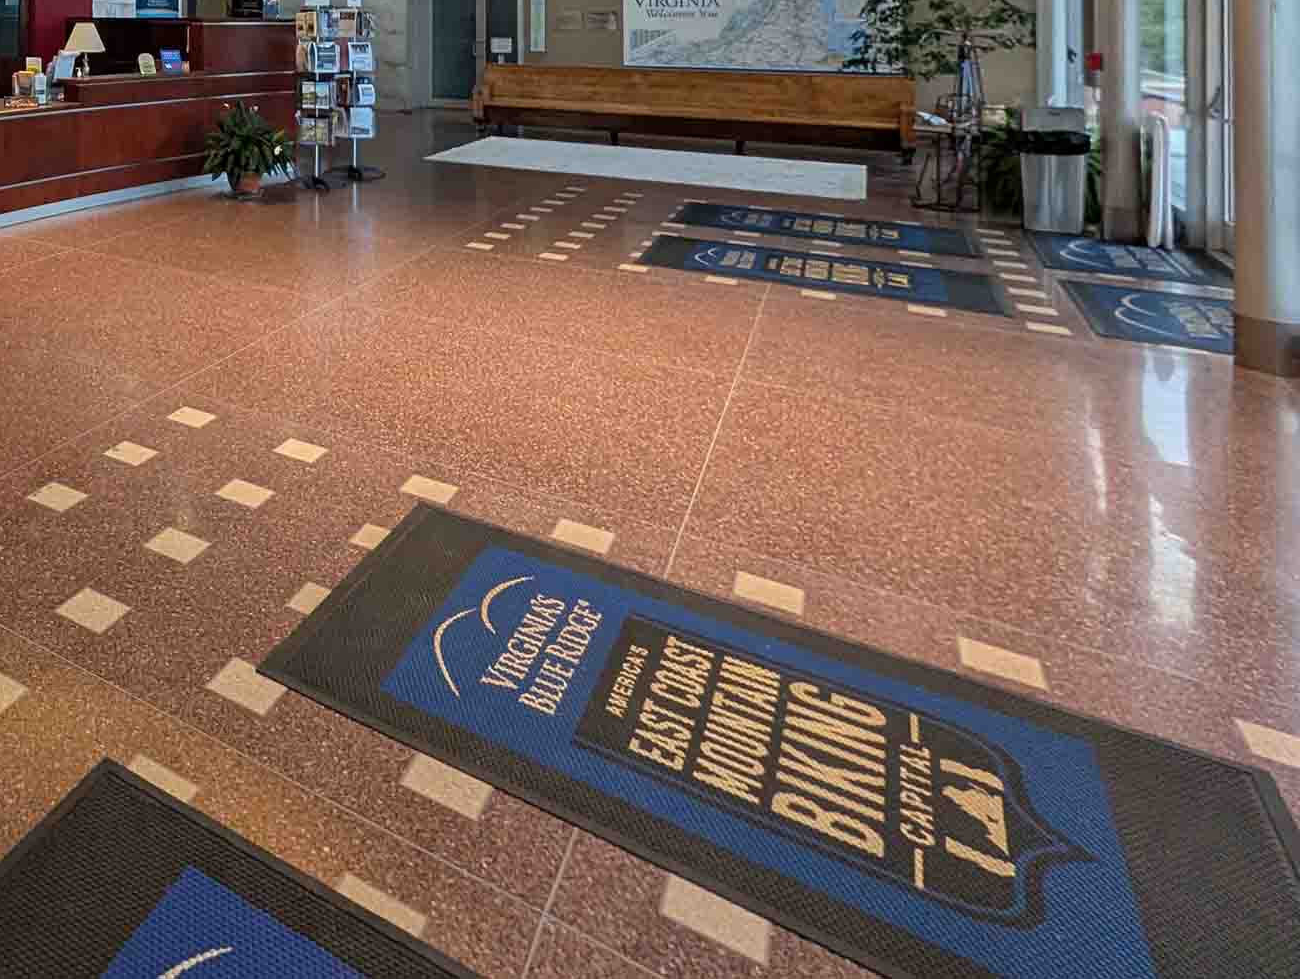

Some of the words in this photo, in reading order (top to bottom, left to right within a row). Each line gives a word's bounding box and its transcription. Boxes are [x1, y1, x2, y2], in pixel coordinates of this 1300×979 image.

[480, 593, 565, 690] VIRGINIA'S
[605, 644, 649, 718] AMERICA'S
[651, 636, 715, 709] COAST
[518, 658, 574, 716] BLUE
[628, 699, 697, 772] EAST
[693, 655, 781, 806] MOUNTAIN
[771, 681, 887, 859] BIKING
[899, 743, 936, 847] CAPITAL
